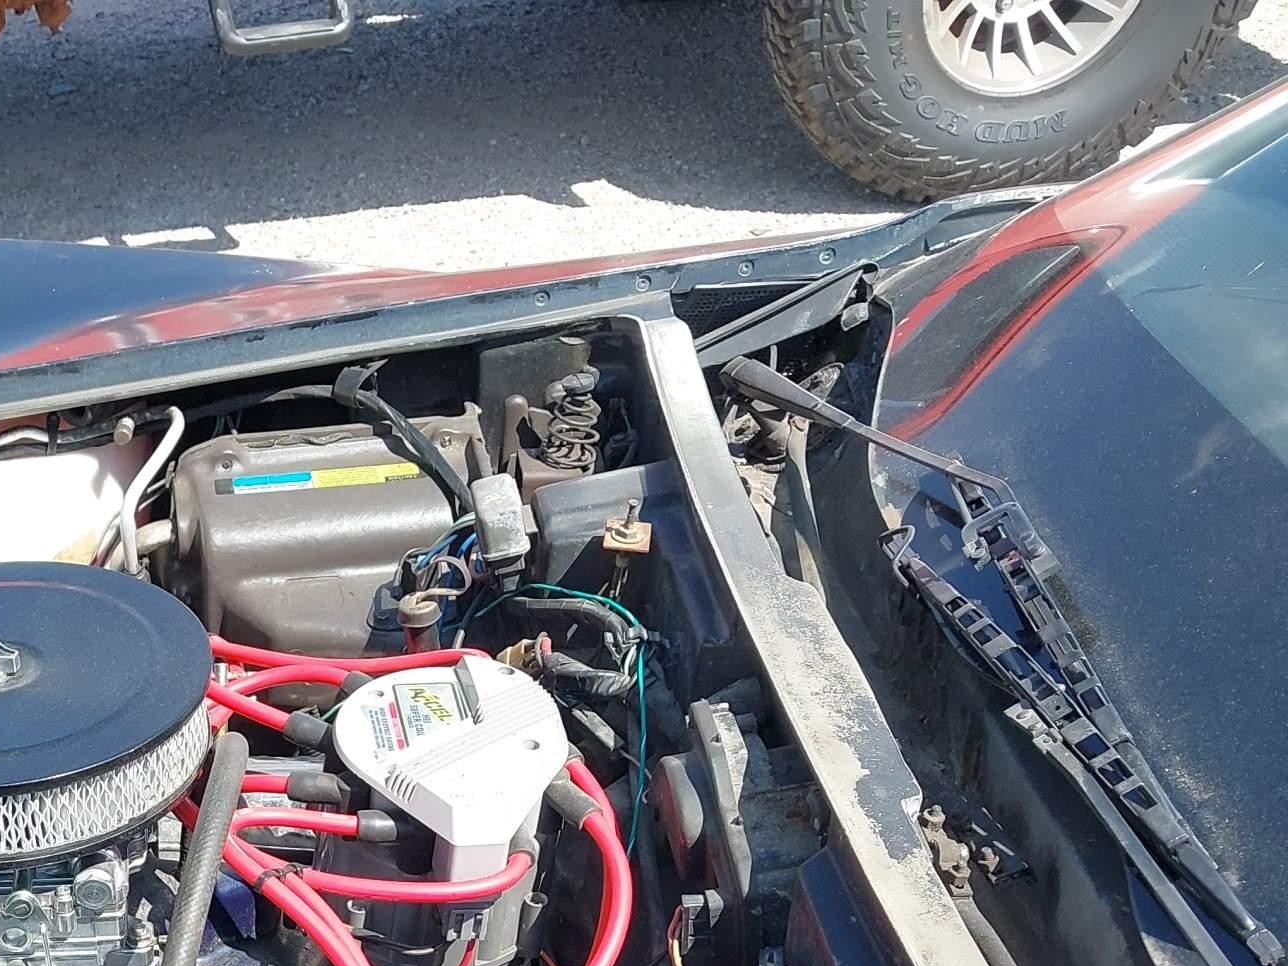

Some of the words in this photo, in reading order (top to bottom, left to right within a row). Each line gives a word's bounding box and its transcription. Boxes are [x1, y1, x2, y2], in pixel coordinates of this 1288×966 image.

[898, 72, 969, 137] HOG
[974, 108, 1068, 144] MUD
[408, 688, 453, 722] ACCEL
[409, 704, 424, 722] SUPER
[413, 721, 425, 737] COIL
